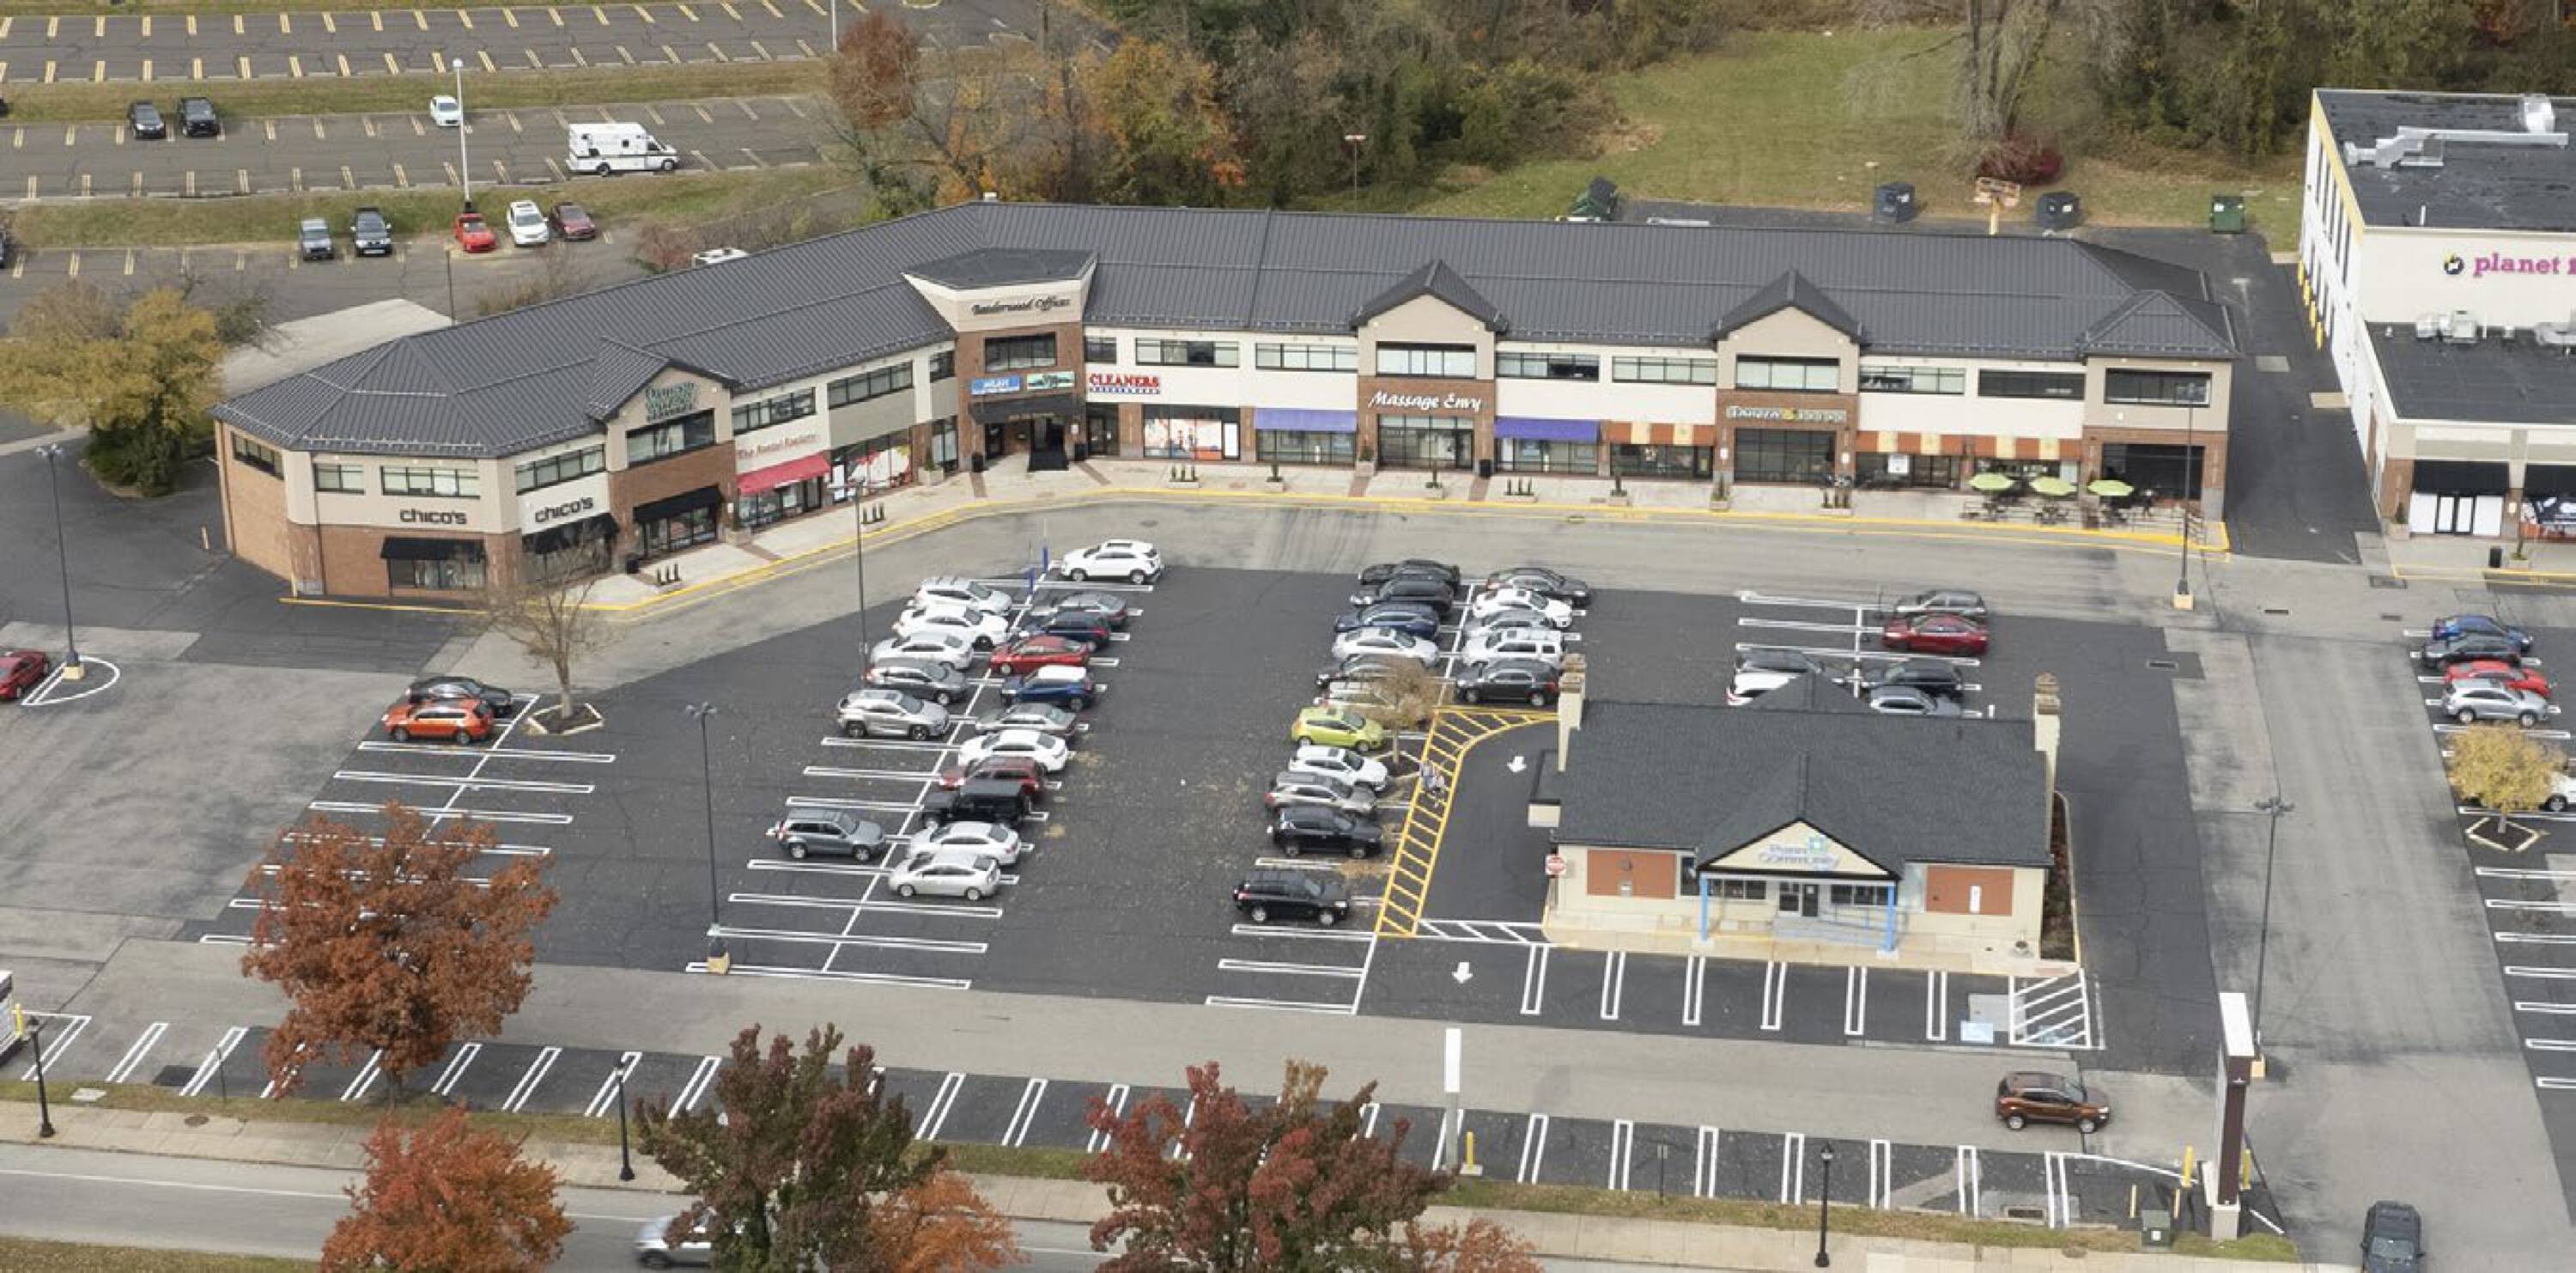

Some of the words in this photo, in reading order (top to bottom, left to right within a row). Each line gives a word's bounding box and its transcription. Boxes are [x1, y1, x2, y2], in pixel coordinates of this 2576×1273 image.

[2473, 253, 2561, 277] planet
[1089, 373, 1159, 387] CLEANERS
[1367, 390, 1440, 411] Massage
[1443, 392, 1482, 412] Envy
[399, 508, 467, 524] chico's
[535, 496, 593, 522] chico's
